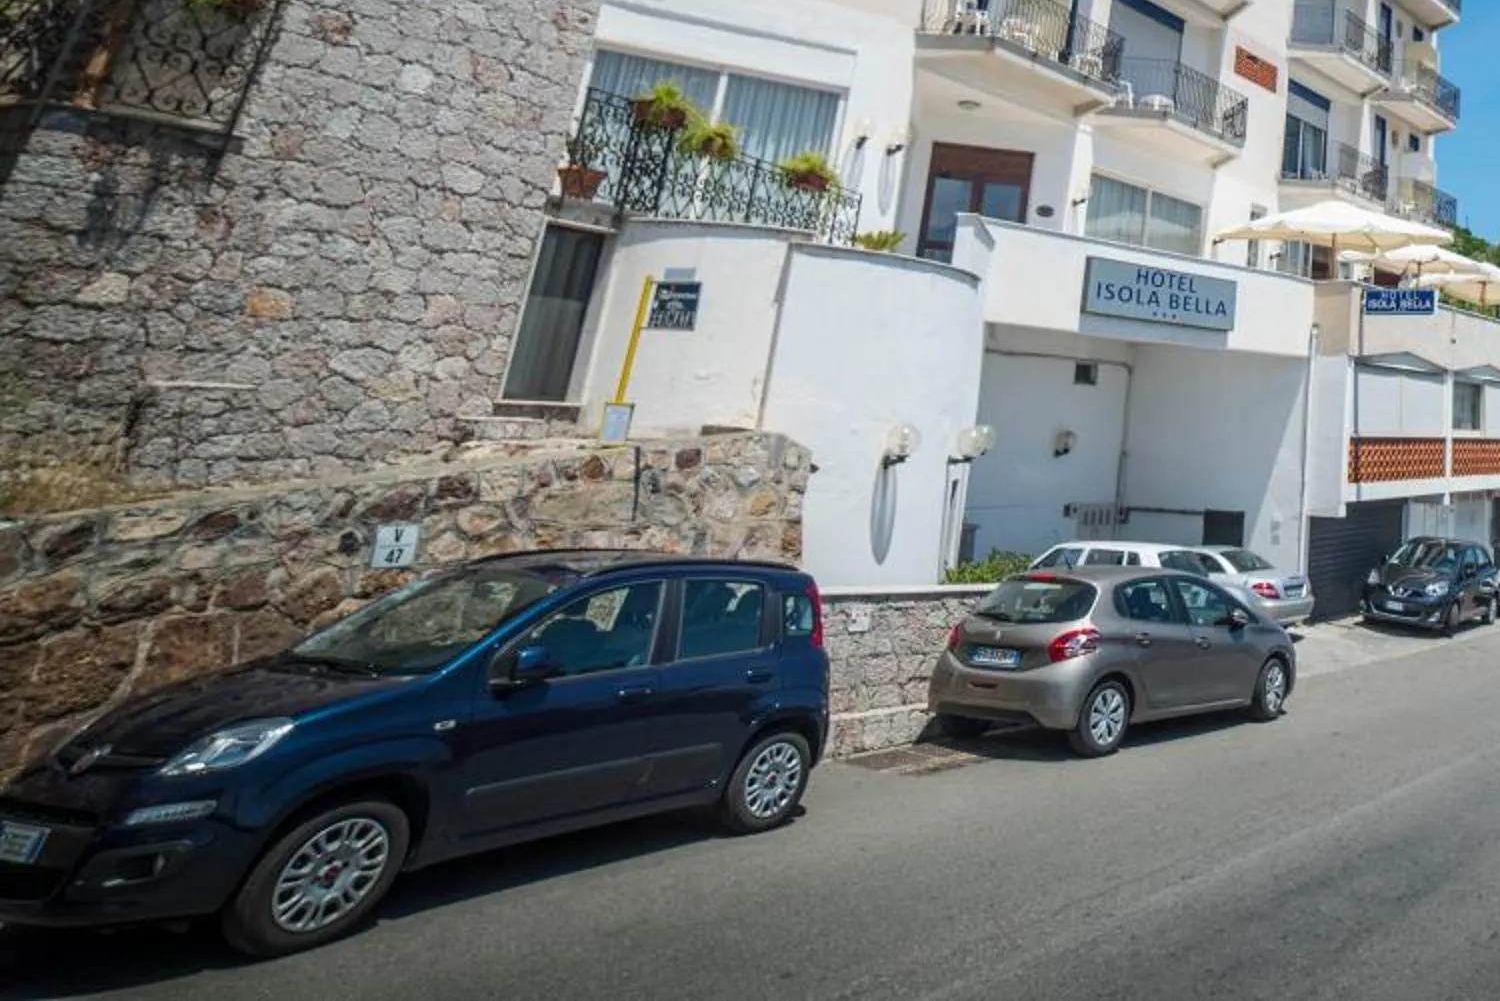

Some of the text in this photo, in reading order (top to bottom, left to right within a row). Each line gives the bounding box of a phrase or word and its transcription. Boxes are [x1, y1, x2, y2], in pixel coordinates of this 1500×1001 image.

[1135, 269, 1196, 293] HOTEL
[1096, 282, 1227, 317] ISOLA BELLA
[1367, 300, 1432, 310] ISOLA BELLA
[384, 548, 405, 564] 47
